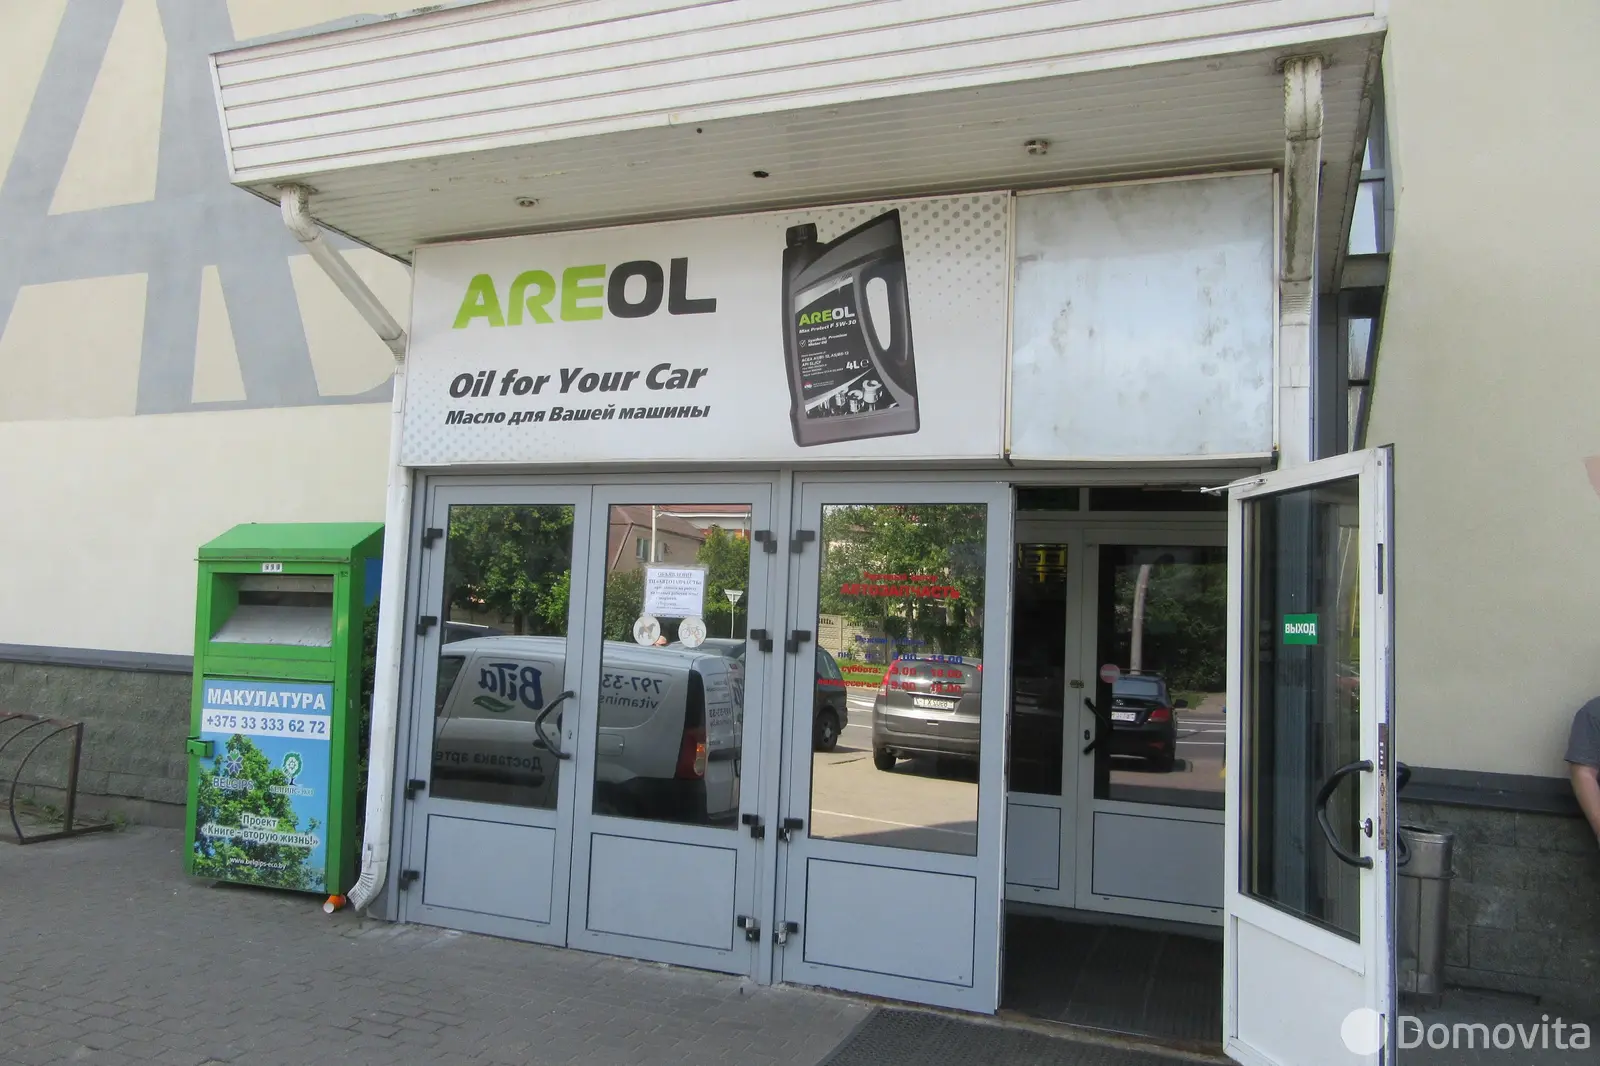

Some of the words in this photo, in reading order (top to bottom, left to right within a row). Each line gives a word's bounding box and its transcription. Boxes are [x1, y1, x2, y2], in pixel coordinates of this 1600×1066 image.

[452, 257, 717, 329] AREOL
[799, 306, 855, 326] AREOL
[835, 320, 857, 328] 5W-30
[449, 370, 497, 398] Oil
[499, 368, 550, 396] for
[559, 367, 640, 394] Your
[645, 363, 709, 391] Car
[445, 410, 506, 425] Масло
[507, 409, 546, 426] для
[549, 404, 616, 422] Вашей
[618, 405, 711, 420] машины
[840, 583, 961, 599] АВТОЗАПЧАСТЬ
[1285, 623, 1316, 636] ВЫХОД
[841, 664, 881, 675] суббота:
[207, 688, 326, 710] МАКУЛАТУРА
[207, 714, 237, 728] +375
[241, 716, 256, 730] 33
[260, 718, 284, 731] 333
[288, 720, 305, 733] 62
[309, 721, 326, 734] 72
[213, 777, 254, 791] BELGIPS
[243, 815, 277, 828] Проект
[203, 825, 235, 836] «Книге
[243, 831, 278, 843] вторую
[280, 834, 318, 846] жизнь!»
